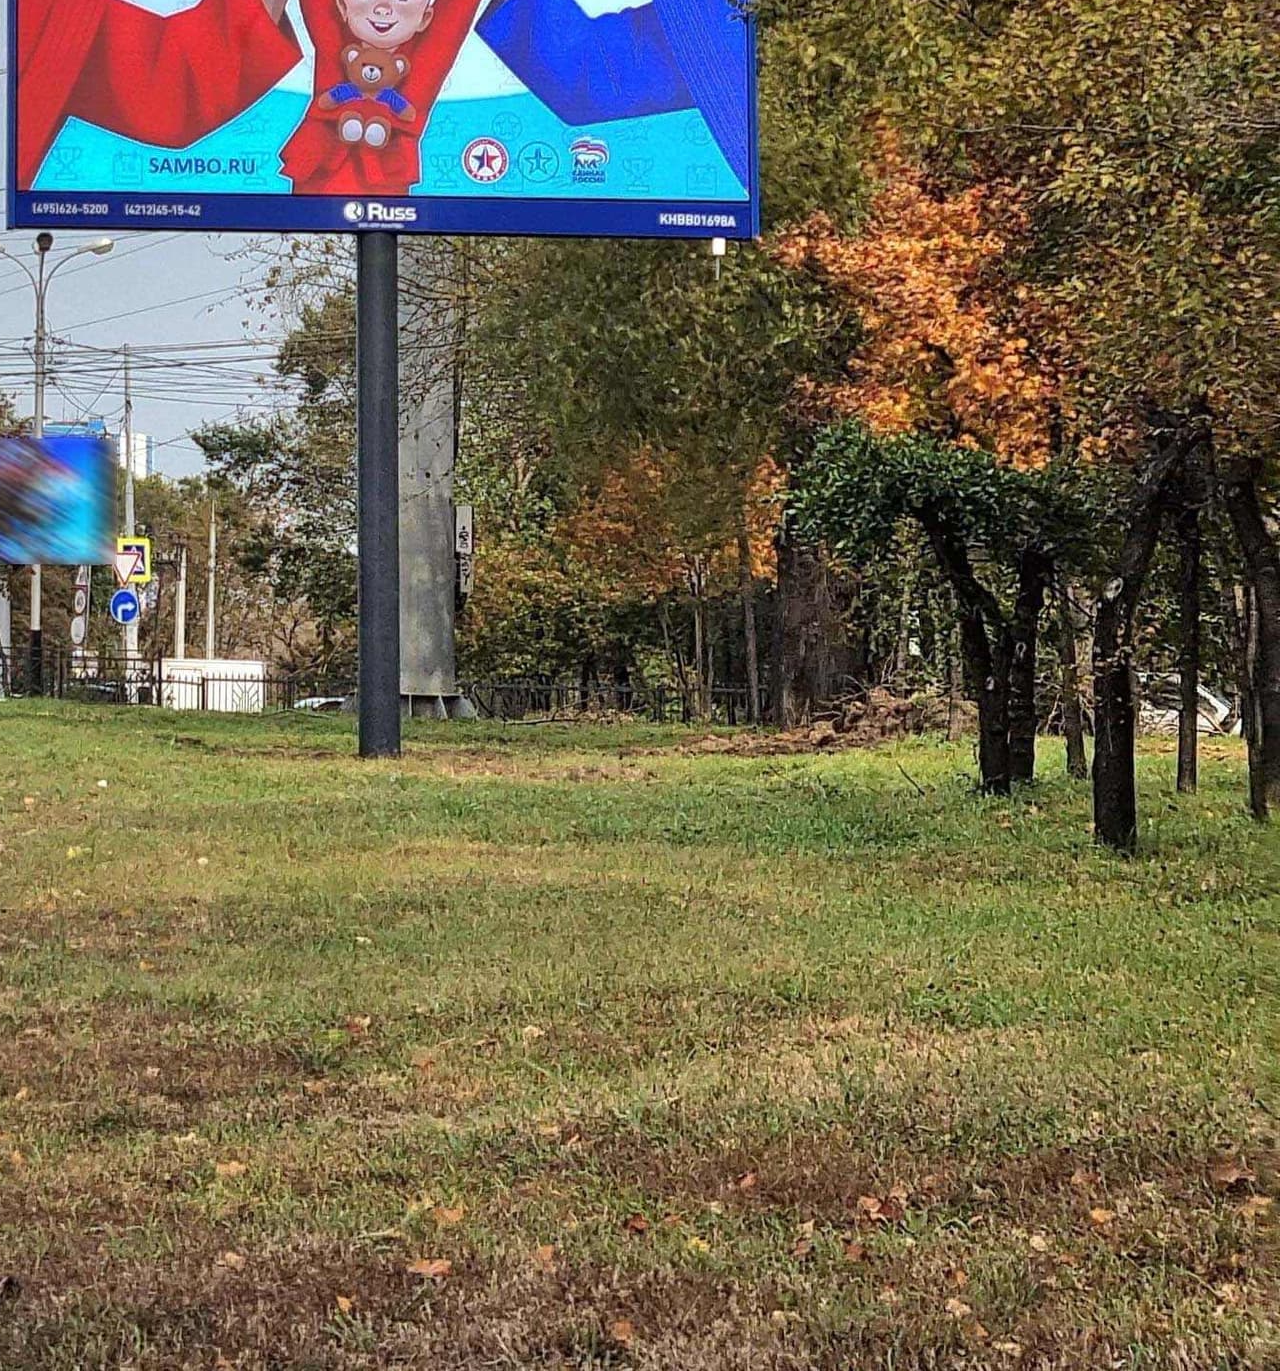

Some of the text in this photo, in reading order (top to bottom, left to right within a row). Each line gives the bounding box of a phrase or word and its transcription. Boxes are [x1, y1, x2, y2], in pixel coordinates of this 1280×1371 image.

[149, 157, 256, 175] SAMBO.RU
[32, 202, 201, 217] (495)626-5200 (4212)45-15-42
[367, 202, 418, 222] Russ
